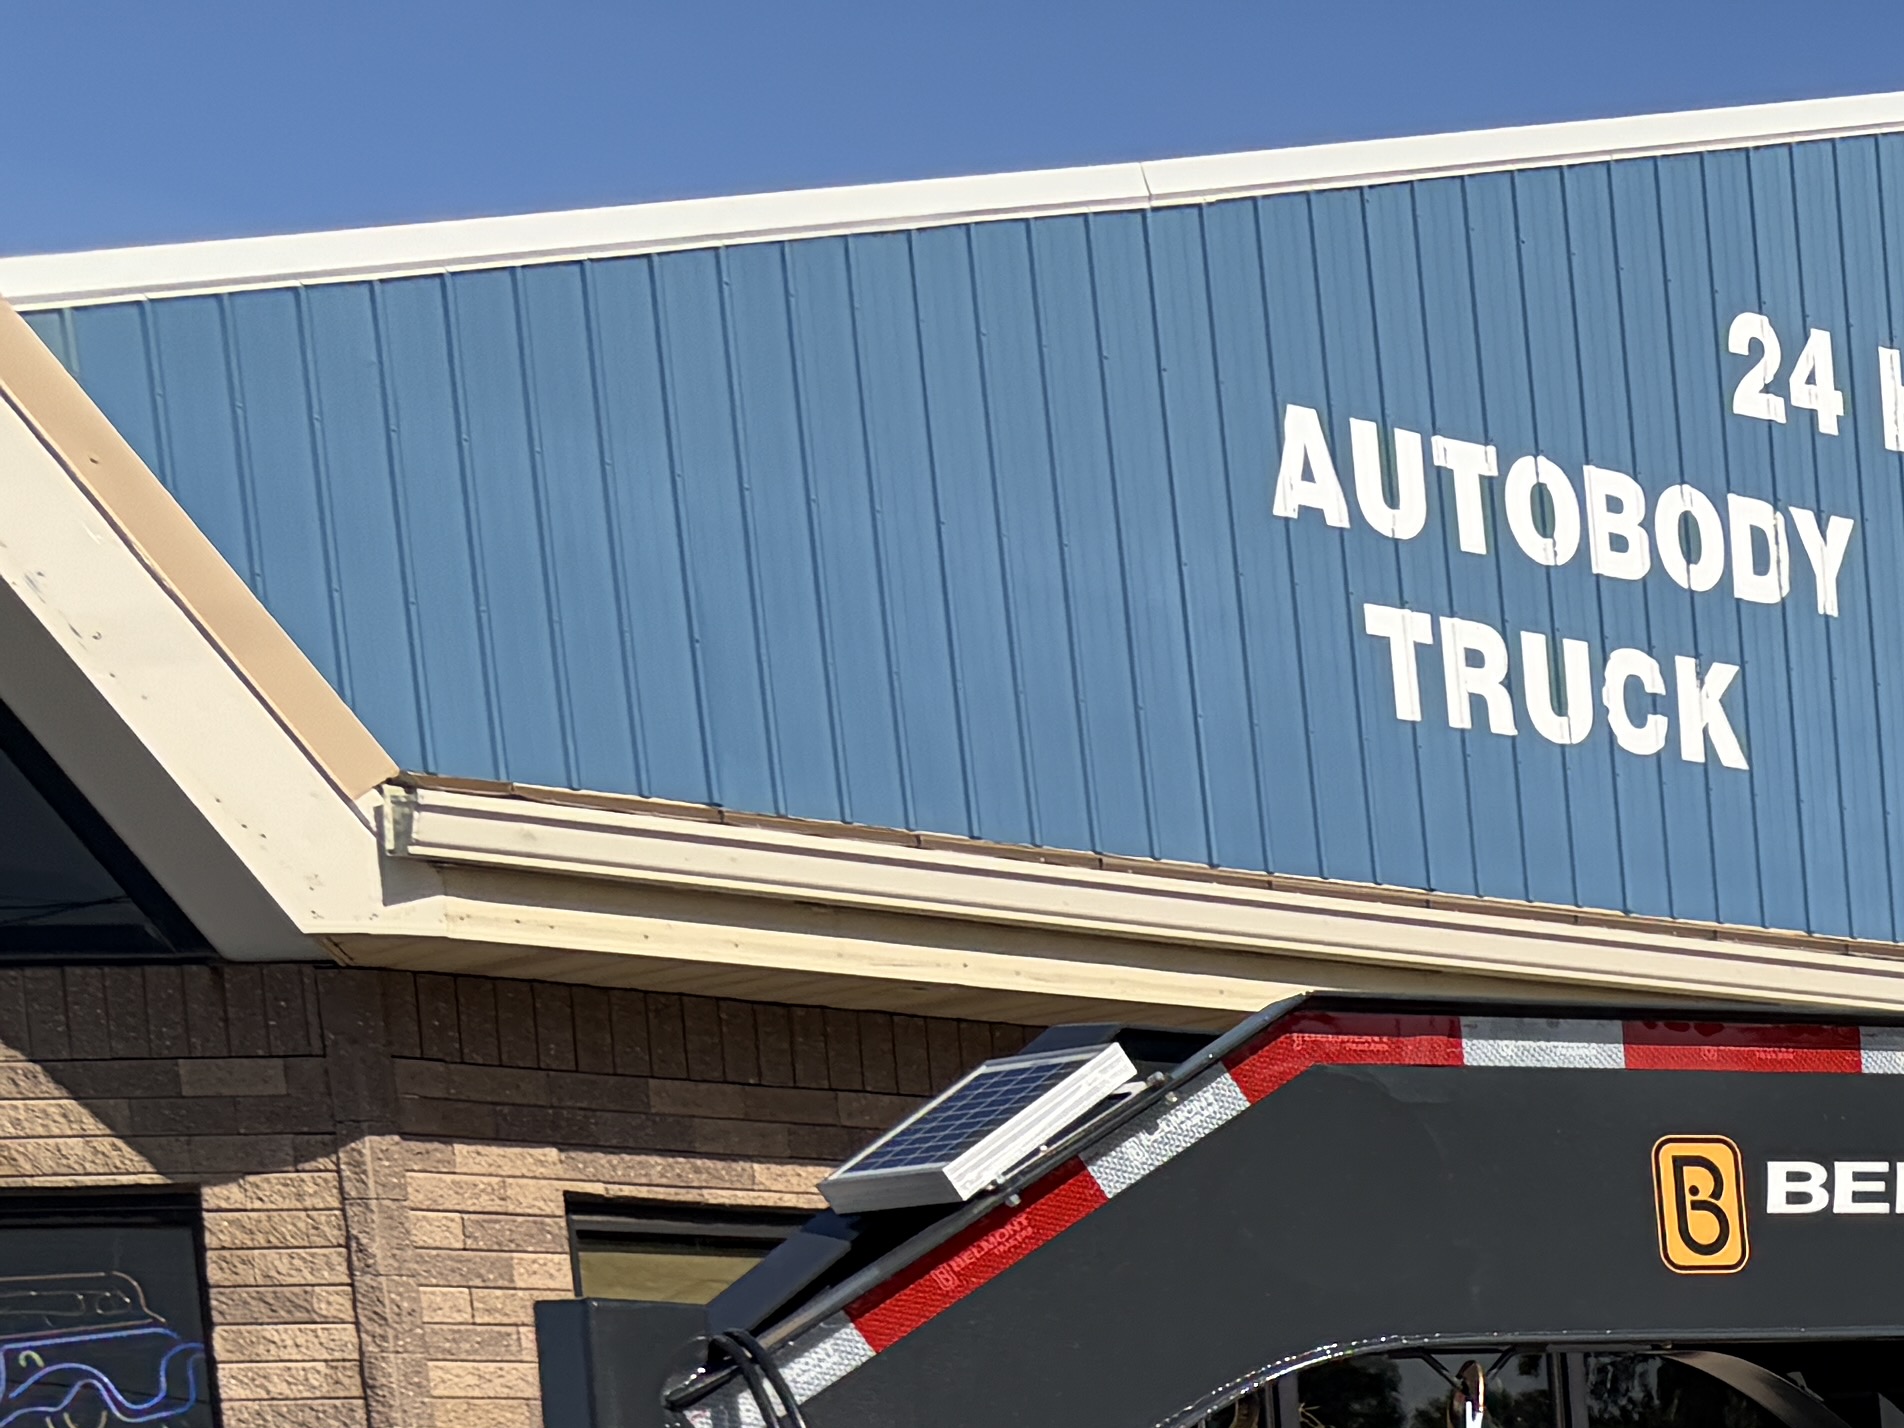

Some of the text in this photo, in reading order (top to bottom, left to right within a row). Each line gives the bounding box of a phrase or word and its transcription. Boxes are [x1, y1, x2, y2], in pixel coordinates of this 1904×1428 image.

[1728, 312, 1844, 437] 24
[1273, 404, 1854, 617] AUTOBODY
[1363, 603, 1749, 770] TRUCK
